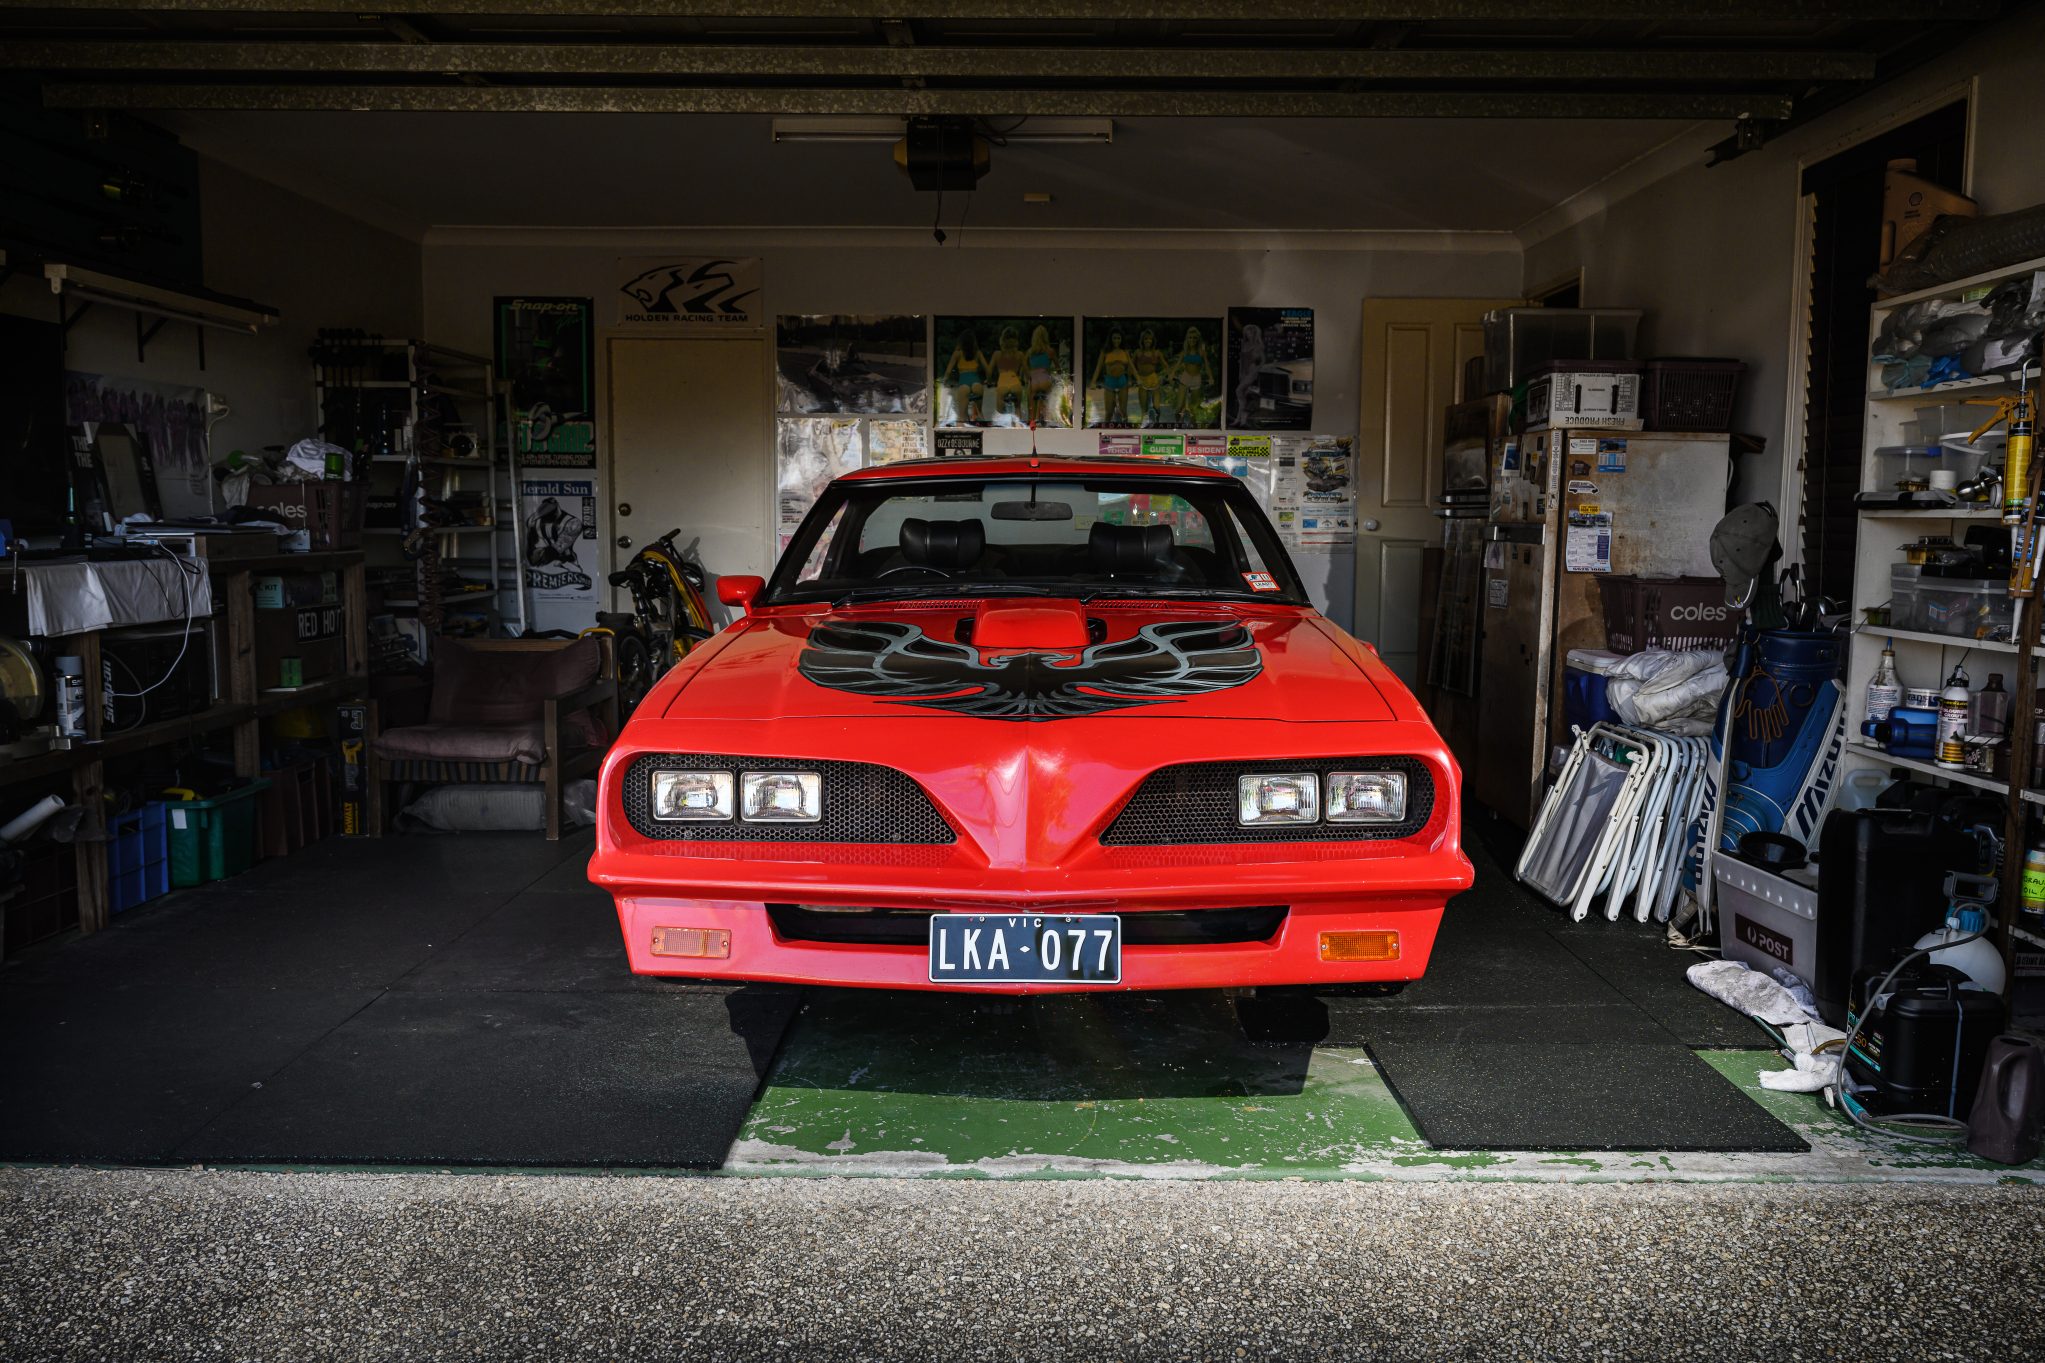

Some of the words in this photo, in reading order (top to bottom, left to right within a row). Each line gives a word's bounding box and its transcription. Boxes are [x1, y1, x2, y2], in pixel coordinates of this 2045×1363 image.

[510, 299, 579, 314] Snap-on
[625, 314, 669, 322] HOLDEN
[673, 314, 713, 322] RACING
[718, 314, 748, 322] TEAM
[1565, 417, 1600, 426] PRODUCE
[1602, 417, 1625, 426] FRESH
[1149, 446, 1176, 454] GUEST
[1187, 446, 1225, 454] RESIDENT
[562, 482, 590, 495] Sun
[257, 502, 307, 518] oles
[1670, 602, 1727, 621] coles
[298, 612, 318, 639] RED
[323, 608, 342, 635] HOT
[2023, 887, 2037, 895] OIL
[1008, 917, 1043, 928] VIC
[938, 928, 1010, 971] LKA
[1041, 928, 1113, 972] 077
[1758, 932, 1789, 961] POST
